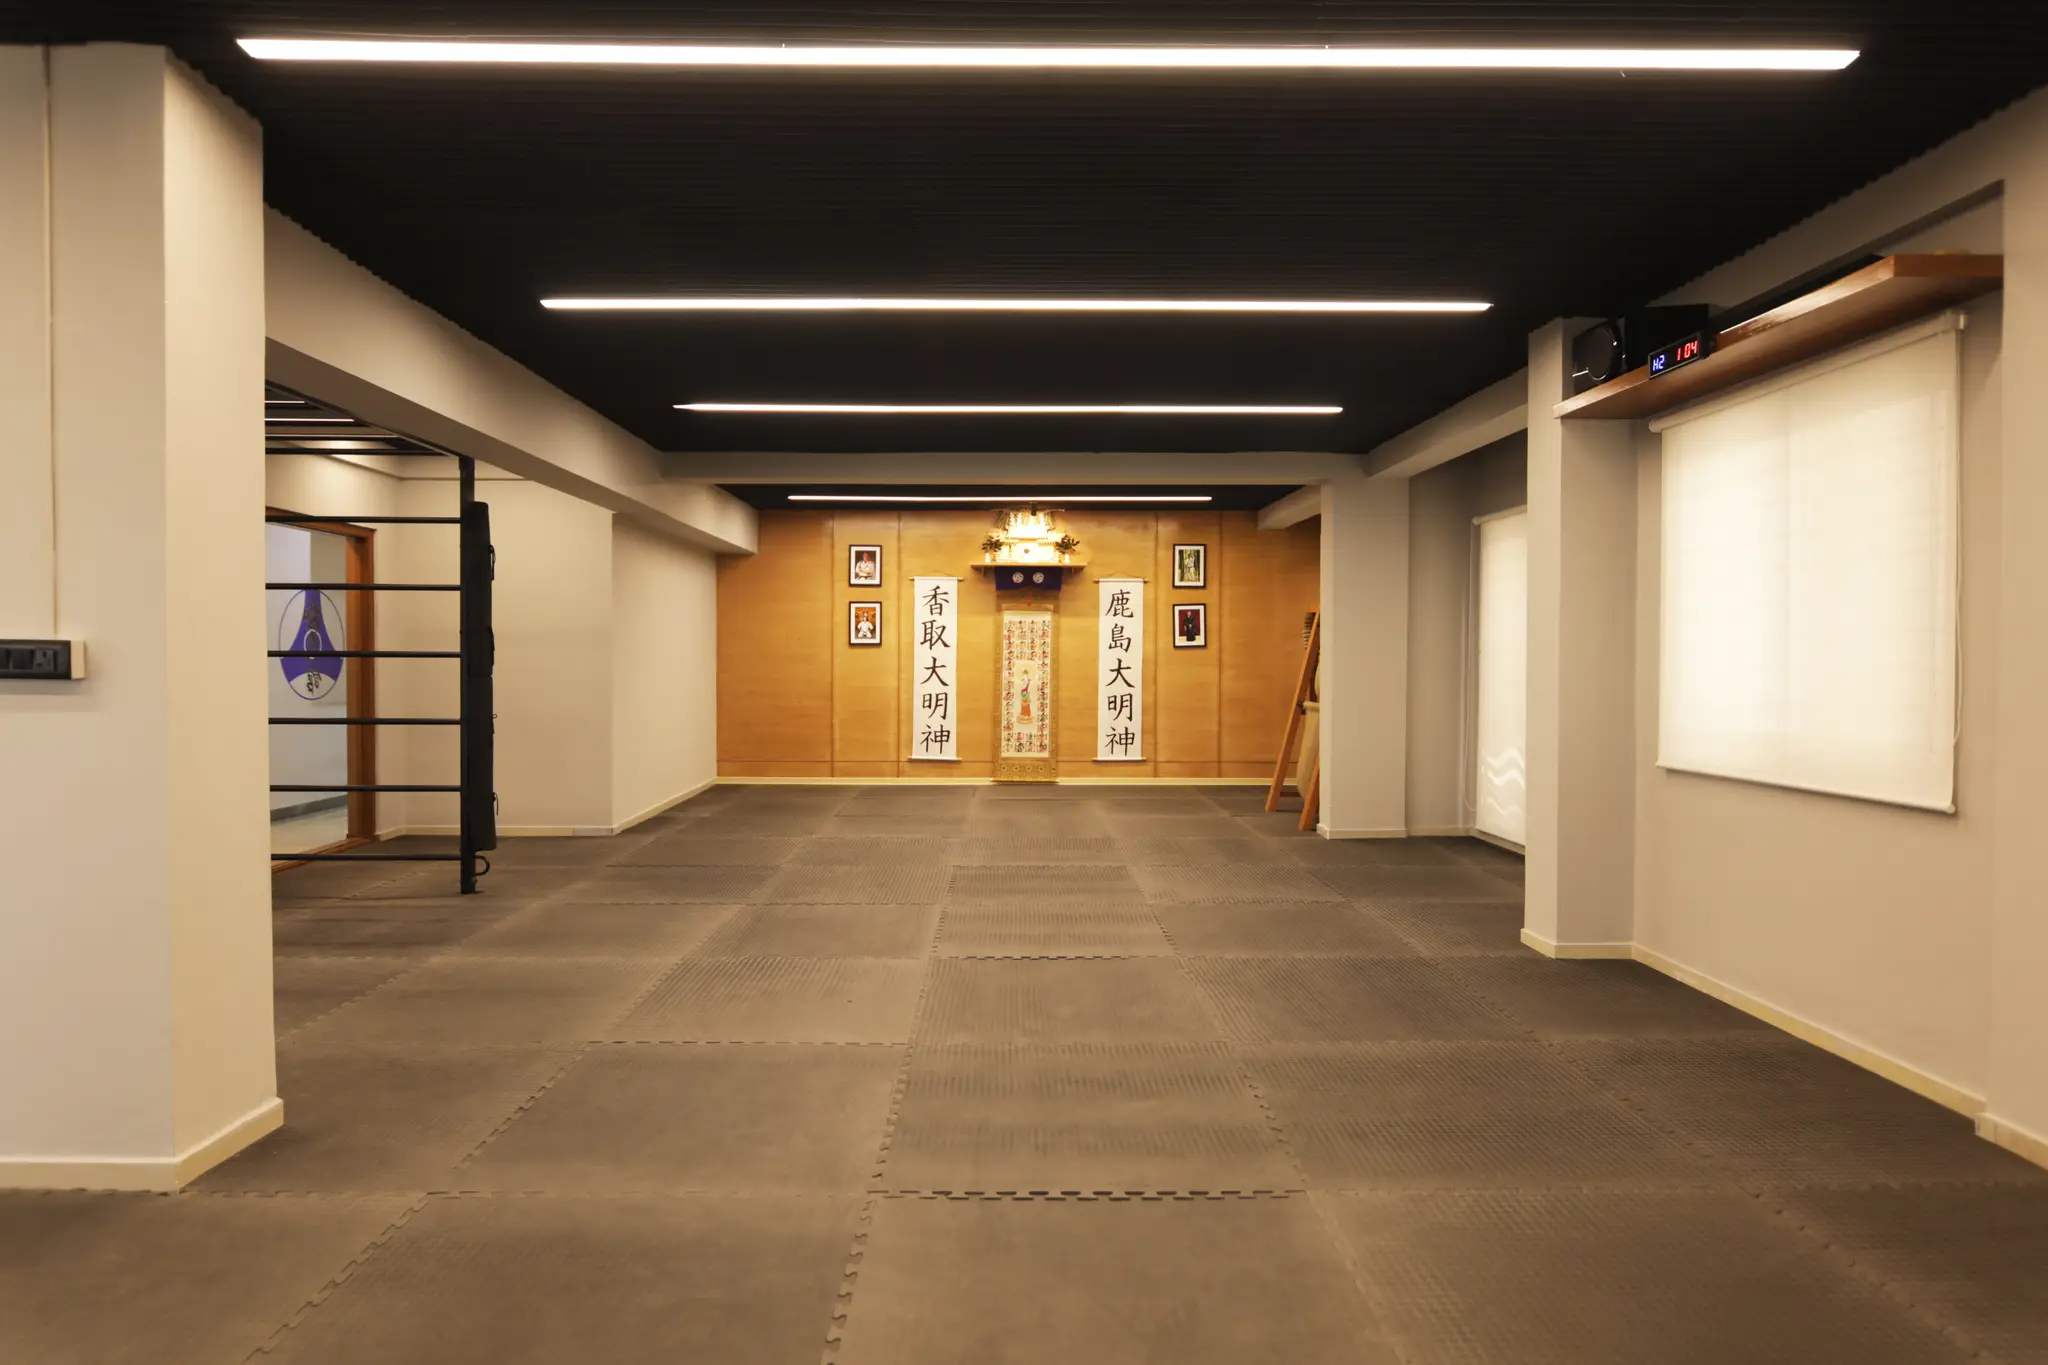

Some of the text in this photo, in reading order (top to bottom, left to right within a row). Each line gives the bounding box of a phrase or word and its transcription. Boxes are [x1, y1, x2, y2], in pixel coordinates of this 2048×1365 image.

[920, 585, 951, 754] 香取大明神
[1105, 589, 1136, 756] 鹿島大明神
